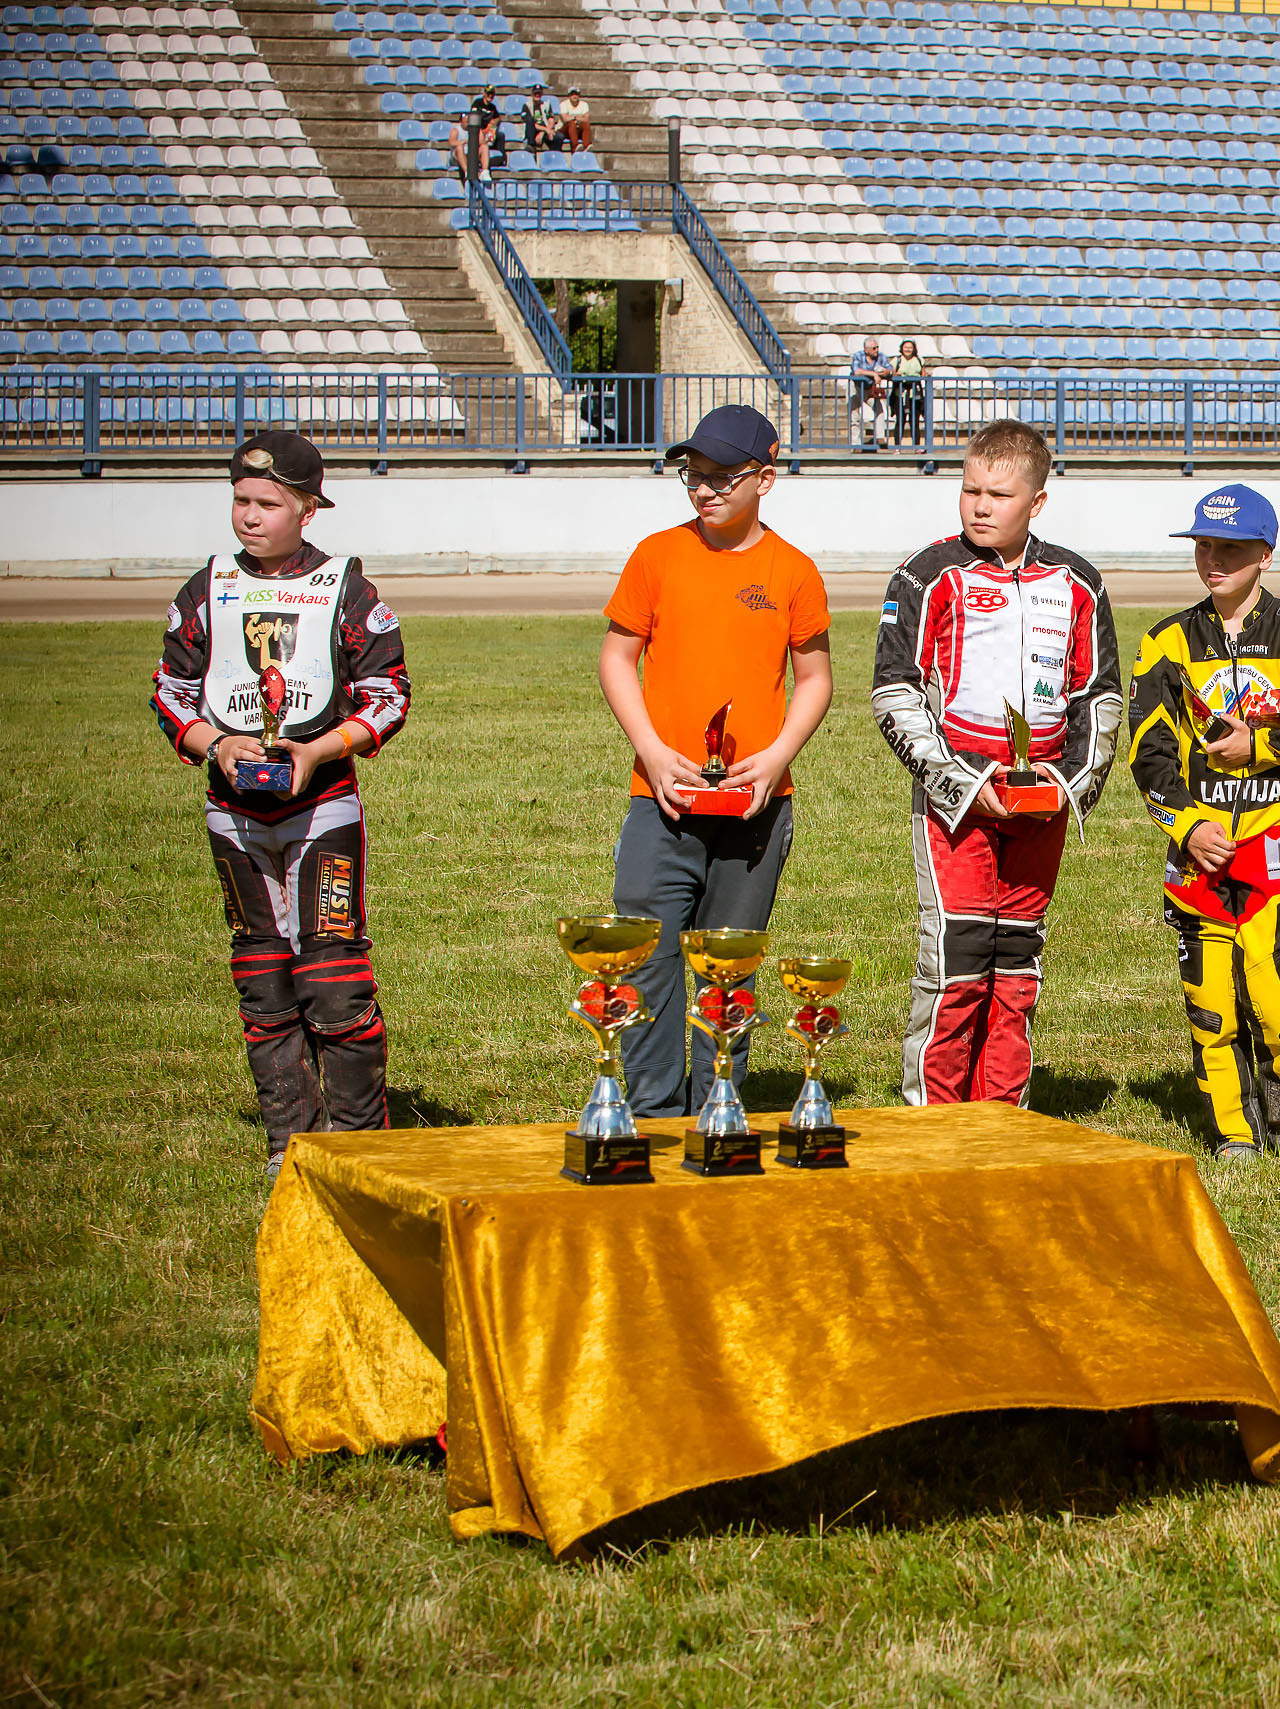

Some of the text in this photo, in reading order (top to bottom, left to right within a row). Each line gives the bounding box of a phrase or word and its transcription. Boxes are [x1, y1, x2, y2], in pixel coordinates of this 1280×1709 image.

[1207, 495, 1236, 507] GRIN
[309, 573, 339, 587] 95
[899, 568, 924, 592] design
[277, 590, 331, 606] Varkaus
[966, 593, 1007, 609] 360
[226, 688, 313, 714] ANKRIT
[879, 711, 931, 785] Rahbek
[937, 775, 964, 806] A/S
[330, 858, 351, 925] MUST
[320, 893, 329, 915] TEAM
